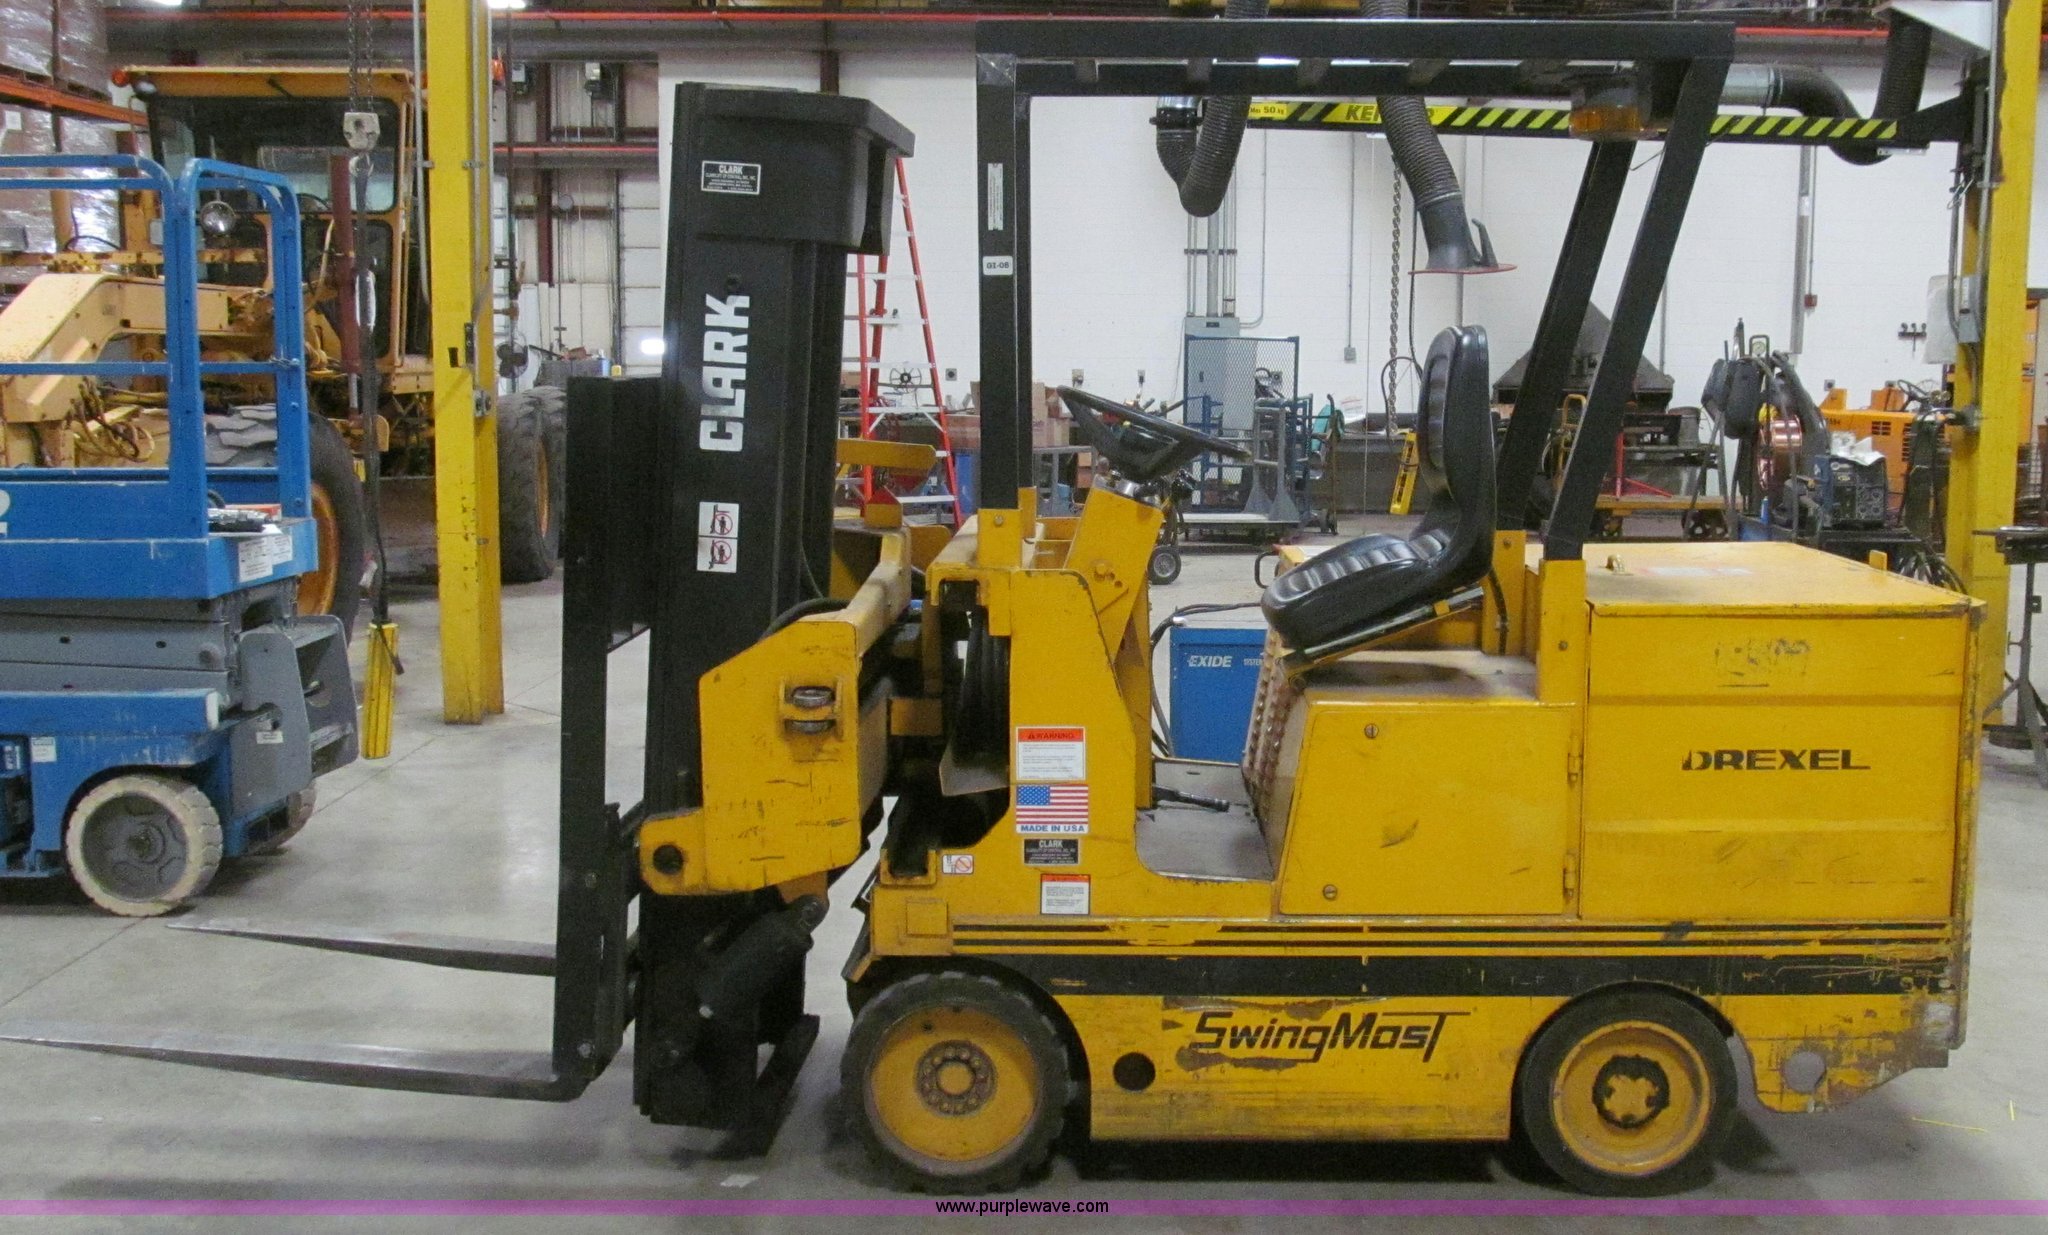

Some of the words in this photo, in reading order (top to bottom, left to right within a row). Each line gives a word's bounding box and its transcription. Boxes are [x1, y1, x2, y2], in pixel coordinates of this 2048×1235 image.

[1263, 106, 1276, 114] 50
[719, 165, 743, 175] CLARK
[699, 292, 751, 452] CLARK
[1187, 655, 1232, 668] EXIDE
[1681, 748, 1871, 771] DREXEL
[1020, 824, 1049, 832] MADE
[1050, 824, 1061, 832] IN
[1063, 824, 1085, 832] USA
[1039, 840, 1063, 848] CLARK
